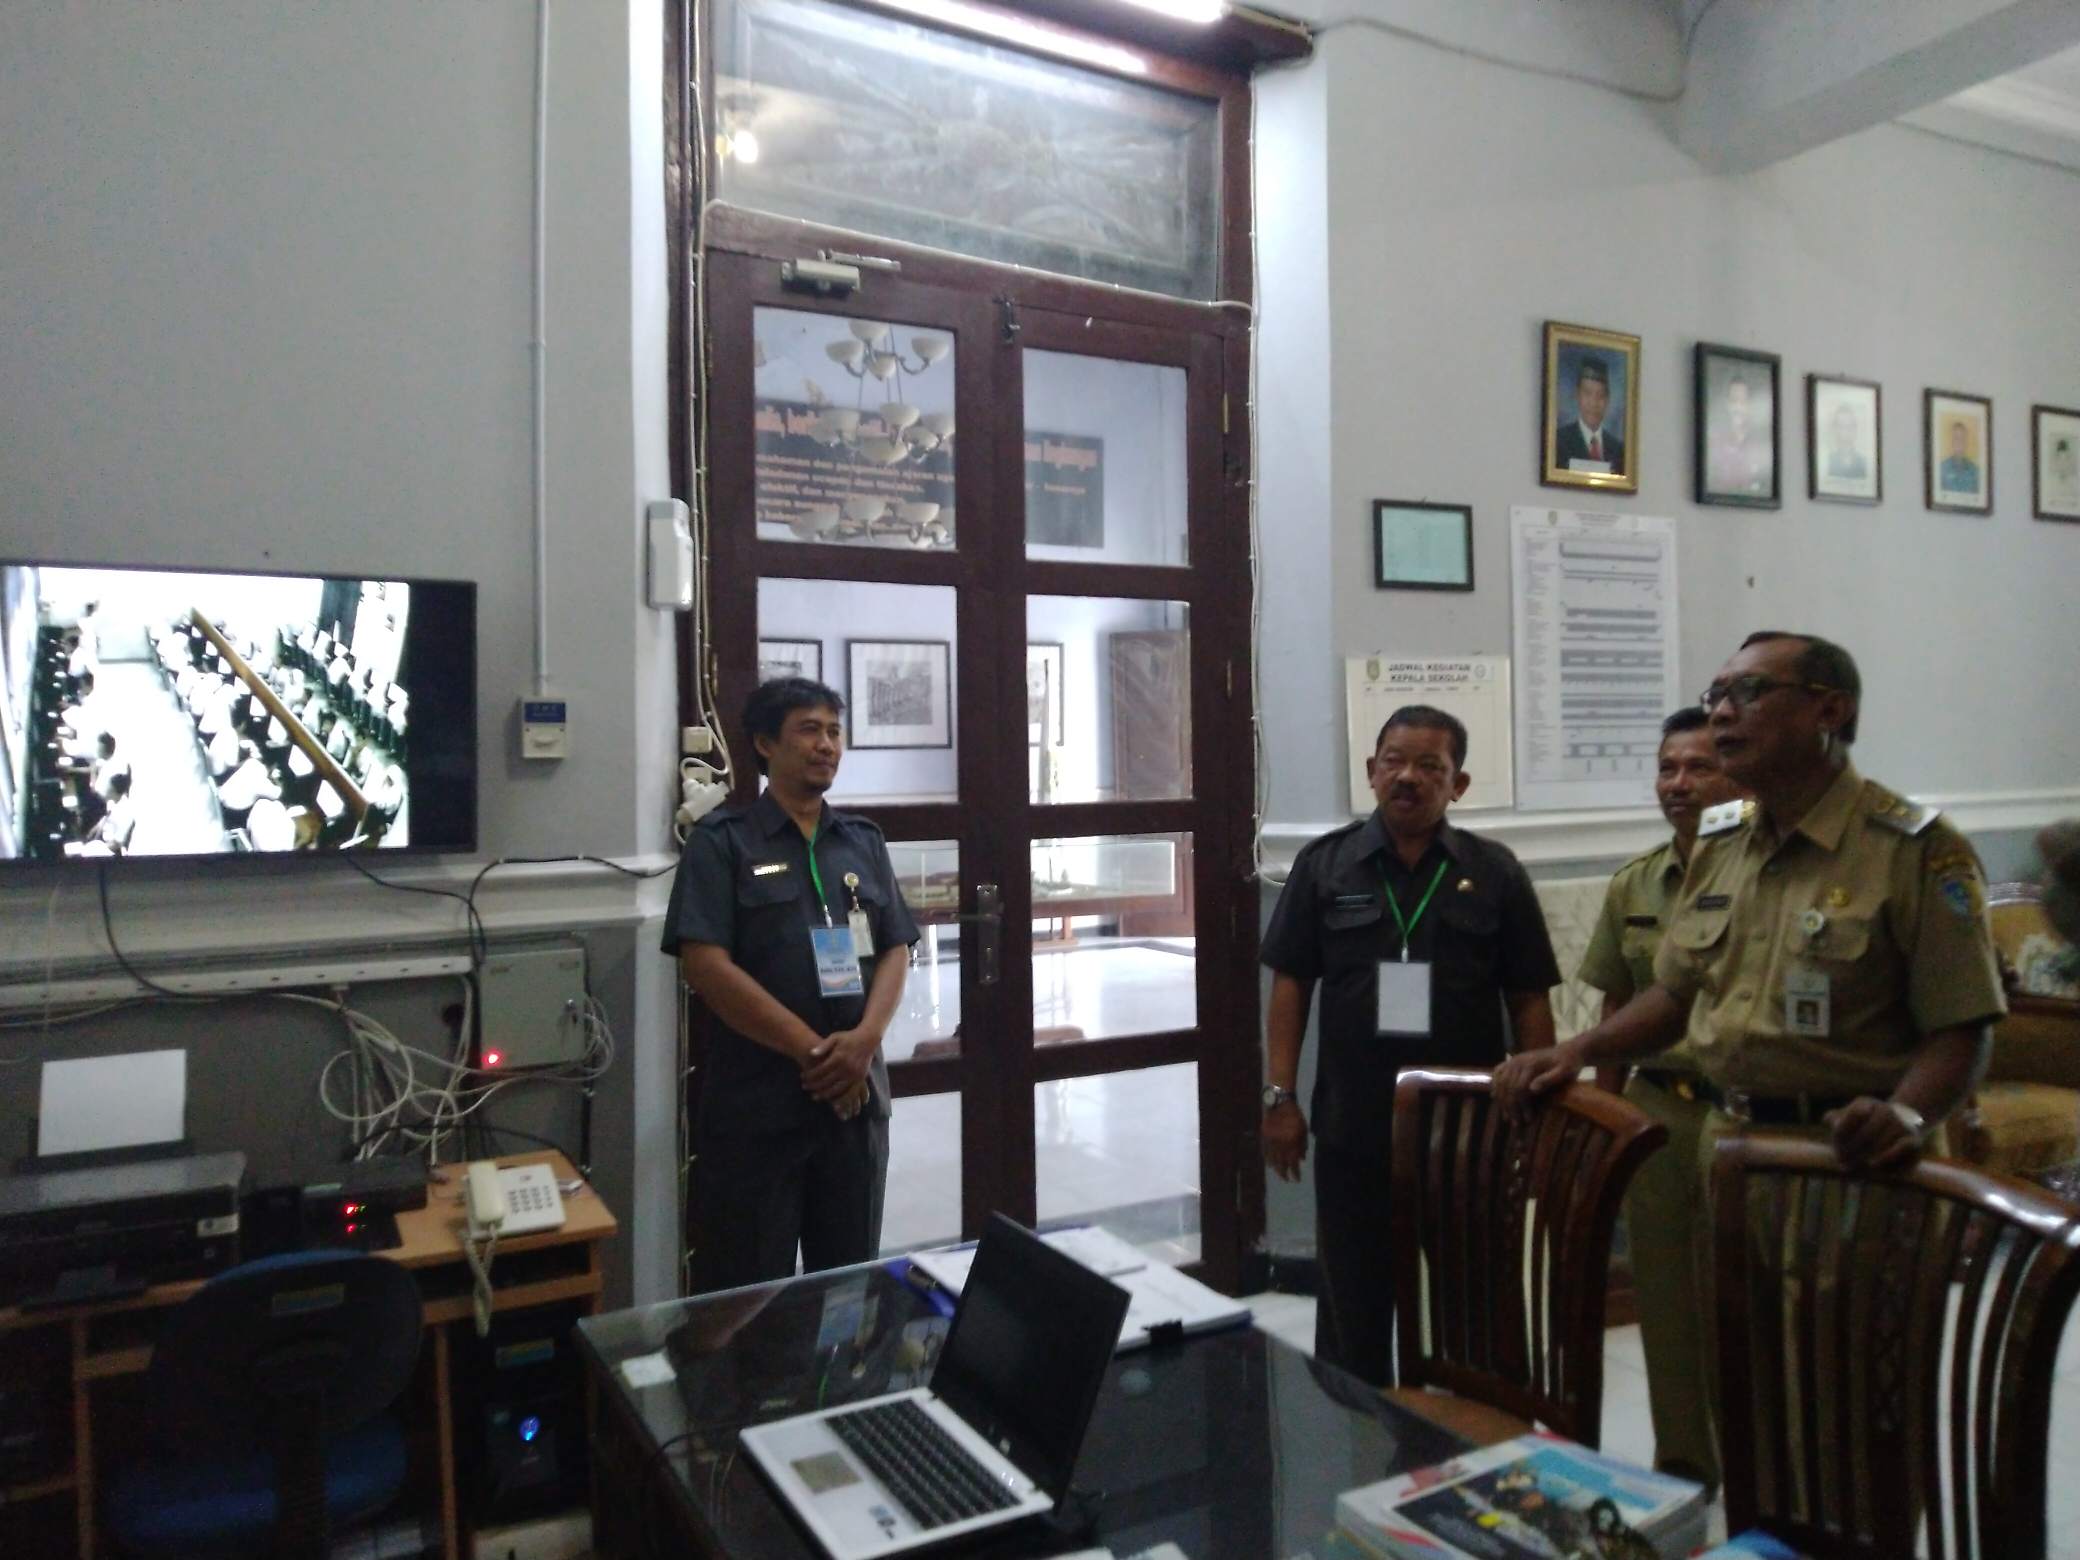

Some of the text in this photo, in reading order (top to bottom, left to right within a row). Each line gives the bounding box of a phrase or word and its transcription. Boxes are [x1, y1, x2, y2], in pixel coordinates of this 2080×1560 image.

[1389, 663, 1471, 672] JADWAL KEGIATAN
[1391, 673, 1469, 682] KEPALA SEKOLAH
